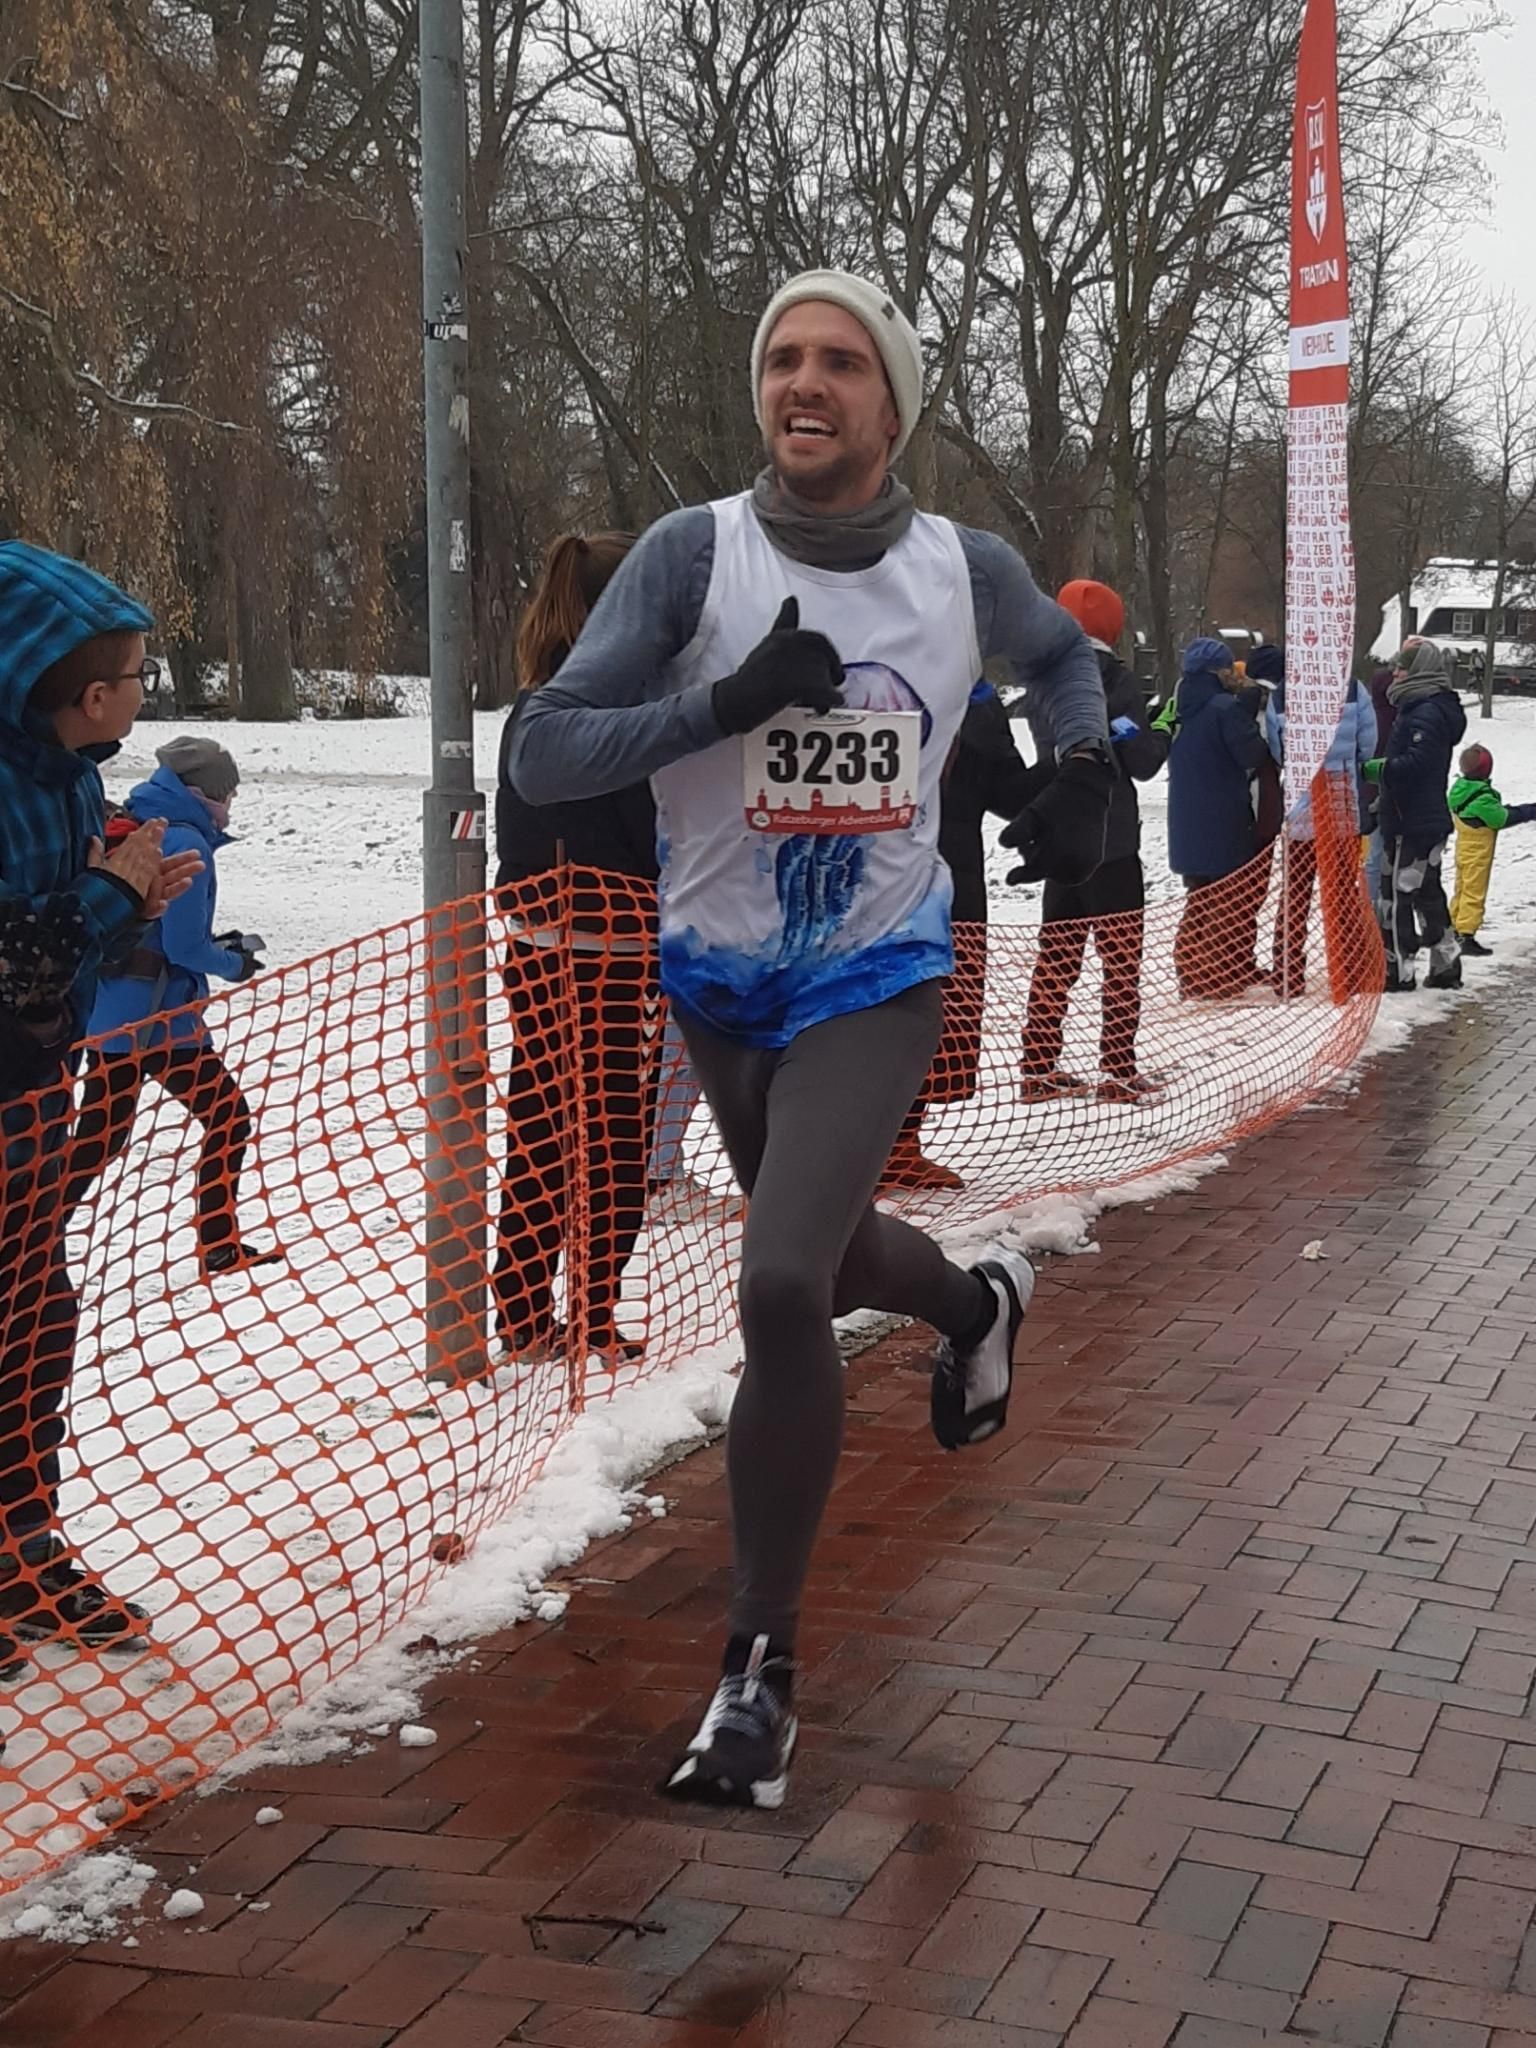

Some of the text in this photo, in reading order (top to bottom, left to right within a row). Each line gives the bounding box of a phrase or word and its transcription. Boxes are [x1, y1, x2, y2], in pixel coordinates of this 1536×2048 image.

[1323, 420, 1344, 432] ATH
[1312, 531, 1331, 543] RAT
[1313, 544, 1333, 556] ZEB
[1288, 728, 1307, 740] ABT
[1289, 740, 1309, 752] EIL
[766, 728, 900, 785] 3233
[1292, 766, 1312, 777] RAT
